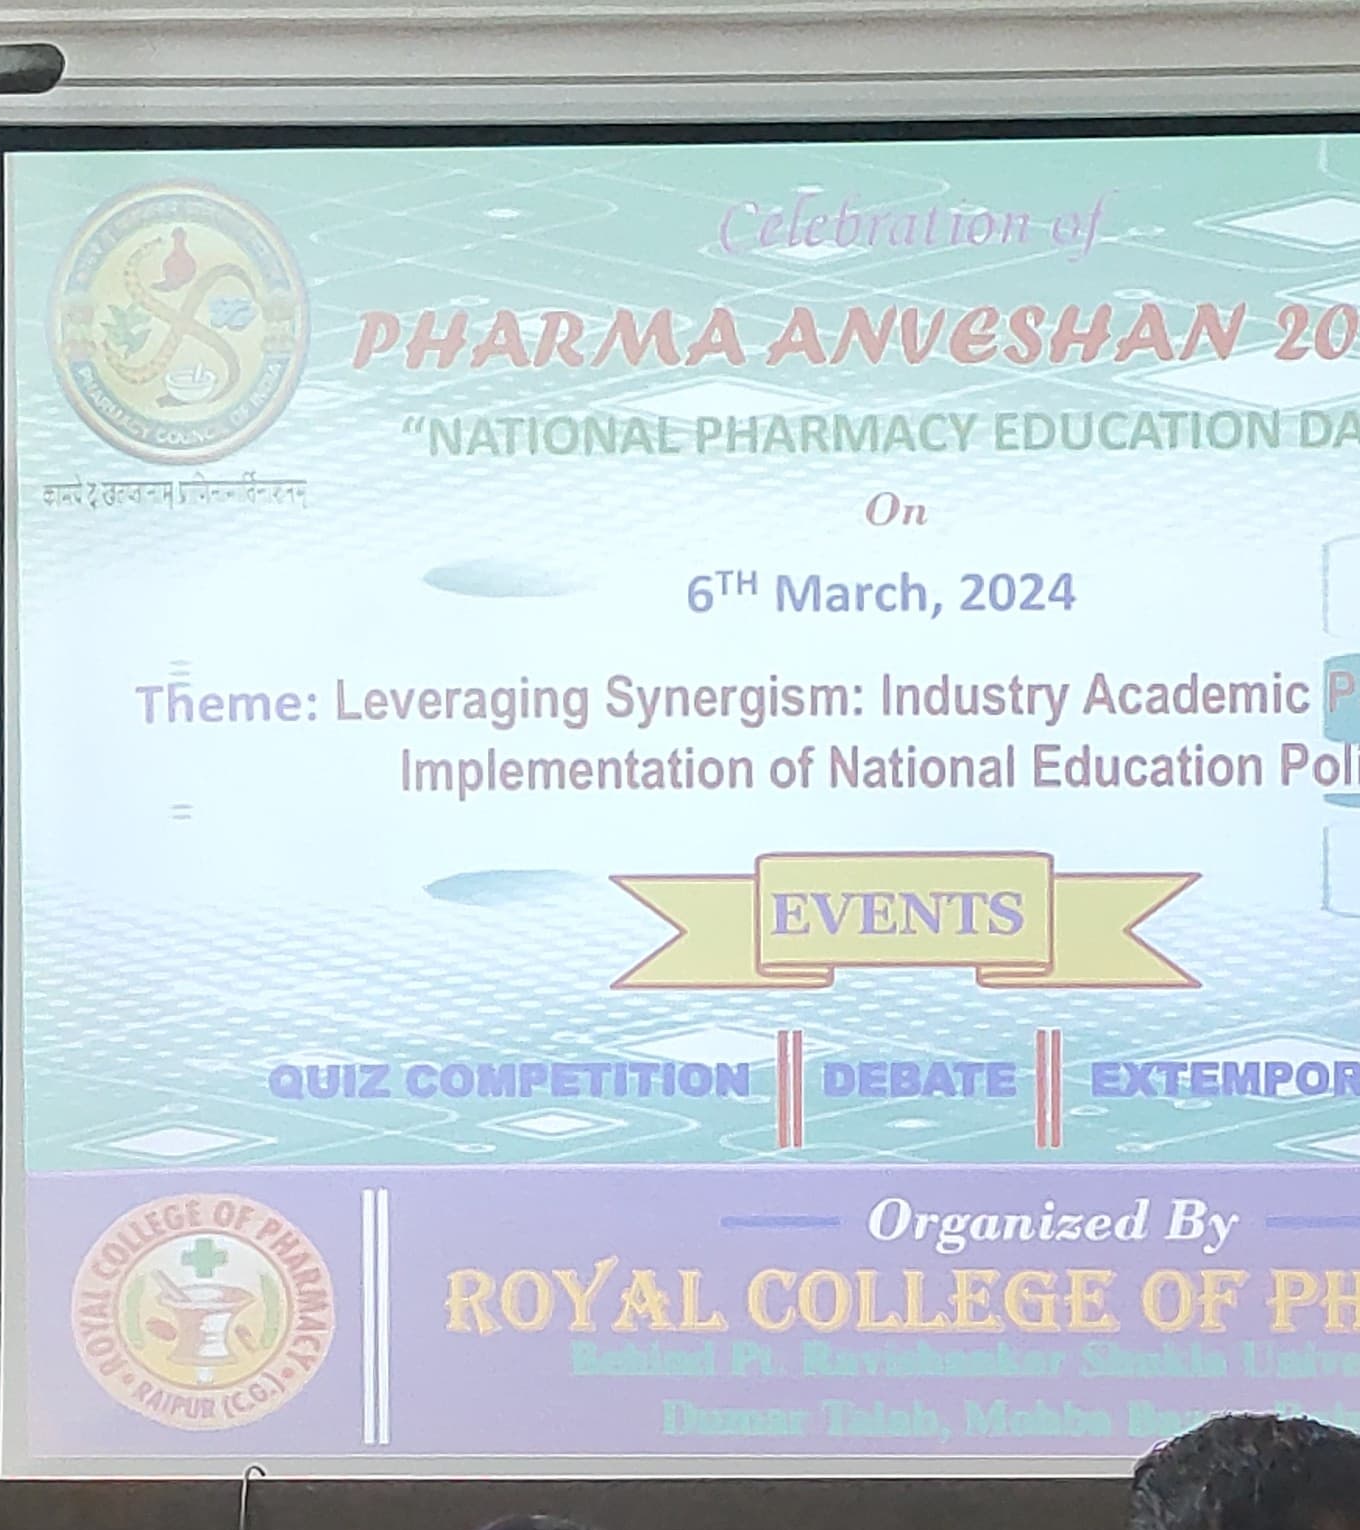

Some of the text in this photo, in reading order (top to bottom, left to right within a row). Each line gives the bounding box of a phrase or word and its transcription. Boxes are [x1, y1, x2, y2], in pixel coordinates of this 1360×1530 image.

[719, 190, 1120, 263] Celebration of
[352, 306, 747, 369] PHARMA
[765, 302, 1247, 366] ANVESHAN
[401, 414, 681, 456] “NATIONAL
[696, 411, 976, 455] PHARMACY
[995, 409, 1281, 451] EDUCATION
[865, 491, 928, 526] On
[687, 569, 1077, 619] 6TH March, 2024
[136, 683, 317, 723] Theme:
[336, 676, 589, 729] Leveraging
[606, 674, 864, 728] Synergism:
[883, 672, 1070, 726] Industry
[1082, 671, 1310, 716] Academic
[401, 747, 753, 801] Implementation
[770, 744, 815, 790] of
[830, 745, 1016, 790] National
[1033, 744, 1262, 789] Education
[770, 891, 1024, 936] EVENTS
[269, 1062, 391, 1099] QUIZ
[406, 1062, 750, 1099] COMPETITION
[823, 1061, 1017, 1099] DEBATE
[868, 1197, 1239, 1254] Organized By
[79, 1200, 328, 1377] ROYAL COLLEGE OF PHARMACY
[445, 1256, 728, 1335] ROYAL
[747, 1268, 1121, 1334] COLLEGE
[1143, 1269, 1250, 1334] OF
[131, 1381, 216, 1419] RAIPUR
